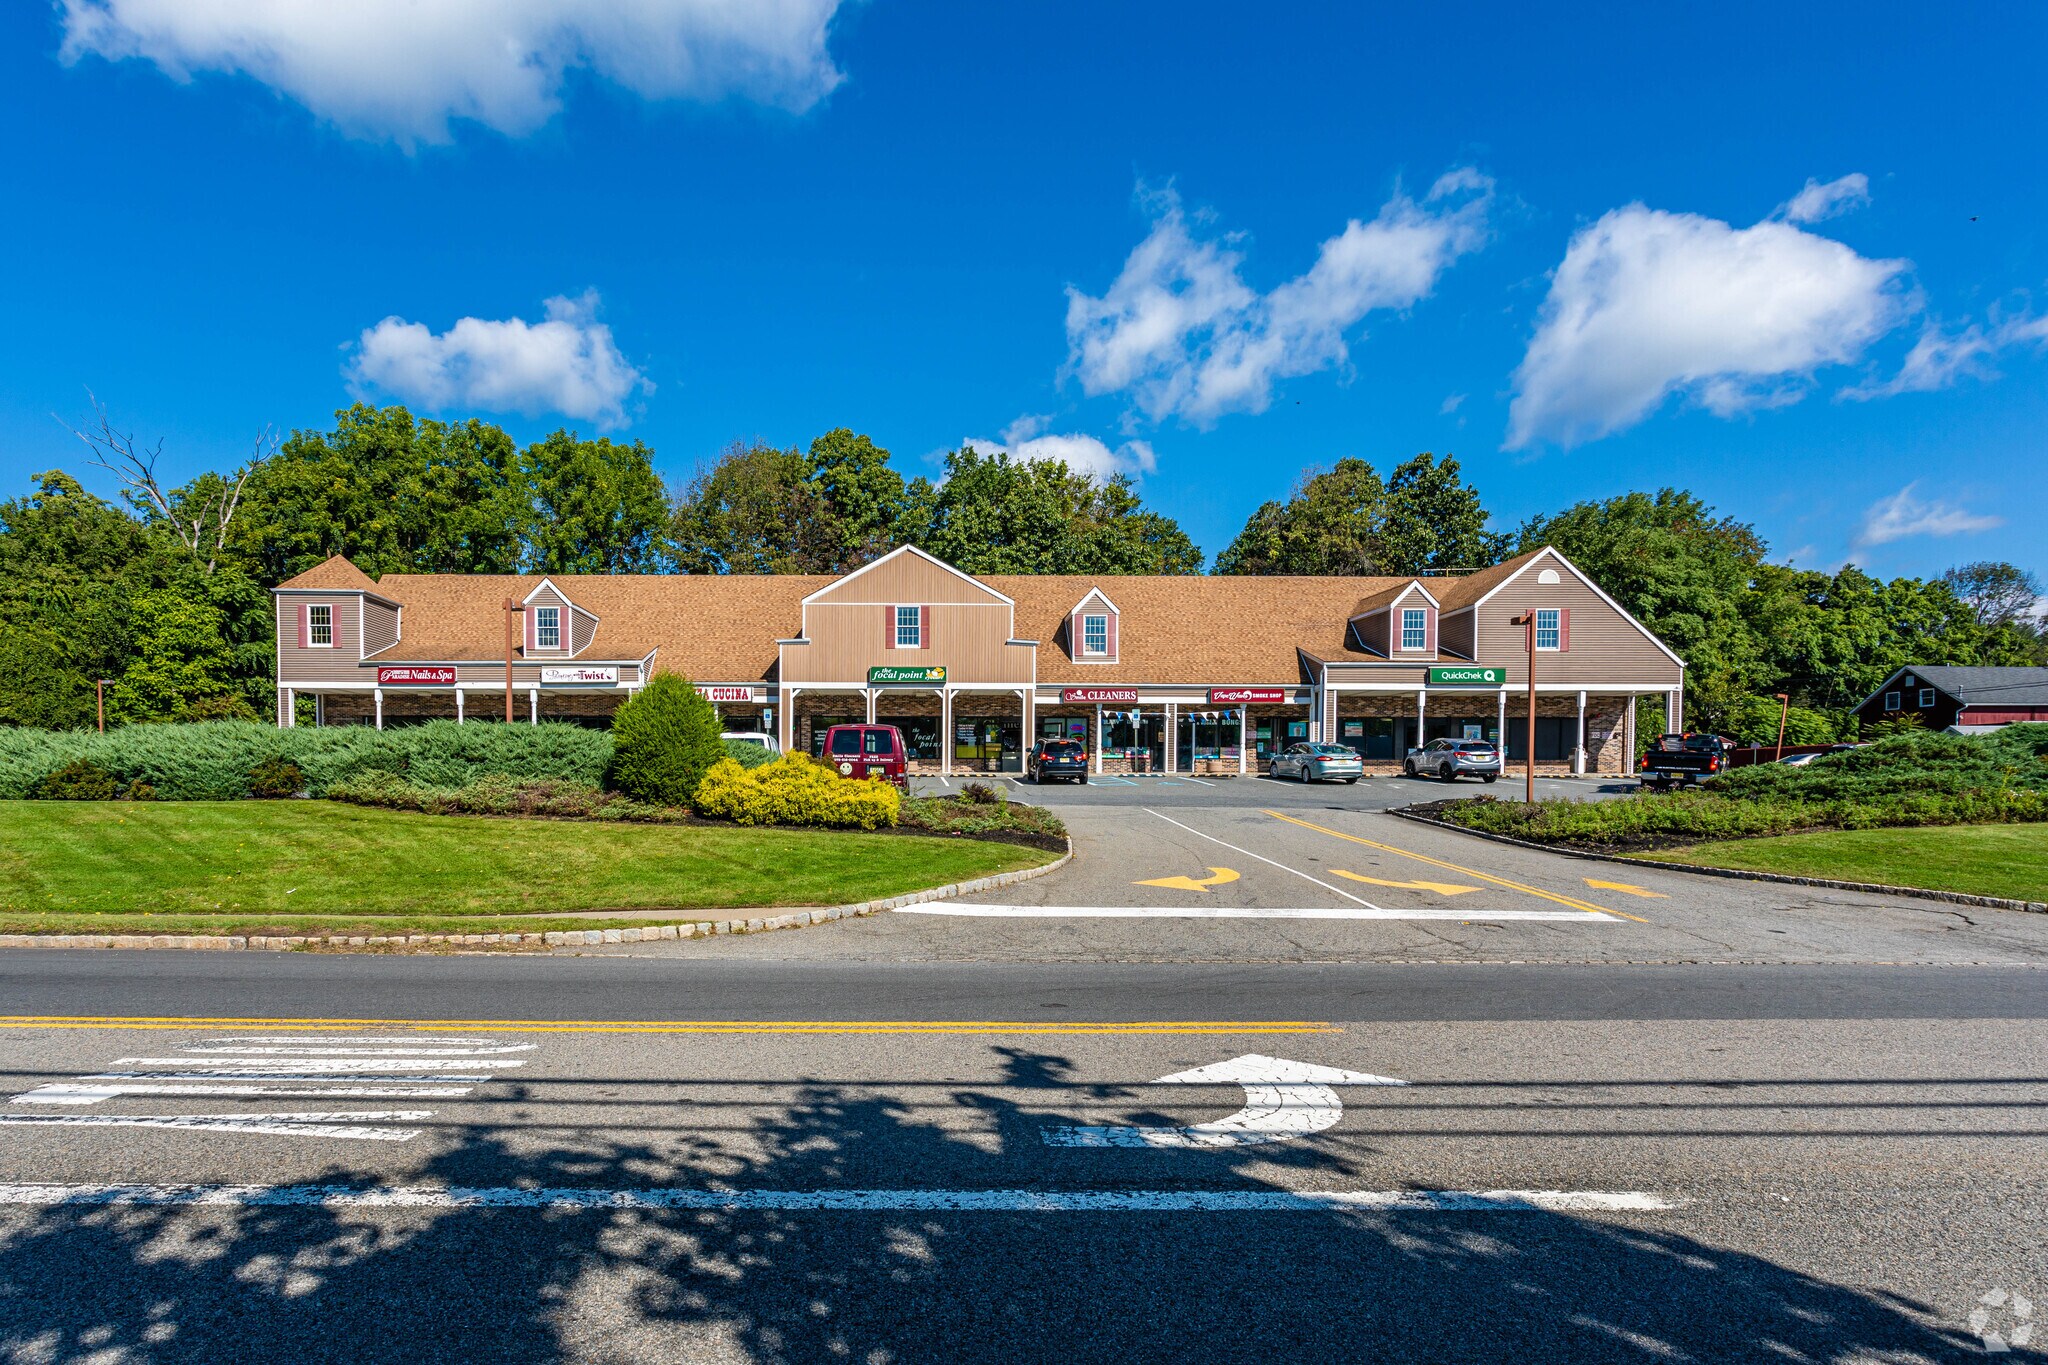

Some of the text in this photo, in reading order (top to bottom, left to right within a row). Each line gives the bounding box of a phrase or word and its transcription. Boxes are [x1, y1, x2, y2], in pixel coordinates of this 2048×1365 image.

[410, 669, 432, 680] Nails
[431, 672, 437, 680] &
[436, 669, 453, 682] Spa
[577, 670, 605, 680] Twist
[871, 670, 897, 681] focal
[897, 670, 924, 681] point
[1441, 671, 1483, 681] QuickChek
[712, 687, 749, 700] CUCINA
[1087, 690, 1137, 701] CLEANERS
[913, 733, 936, 742] focal
[0, 1037, 539, 1141] ONLY
